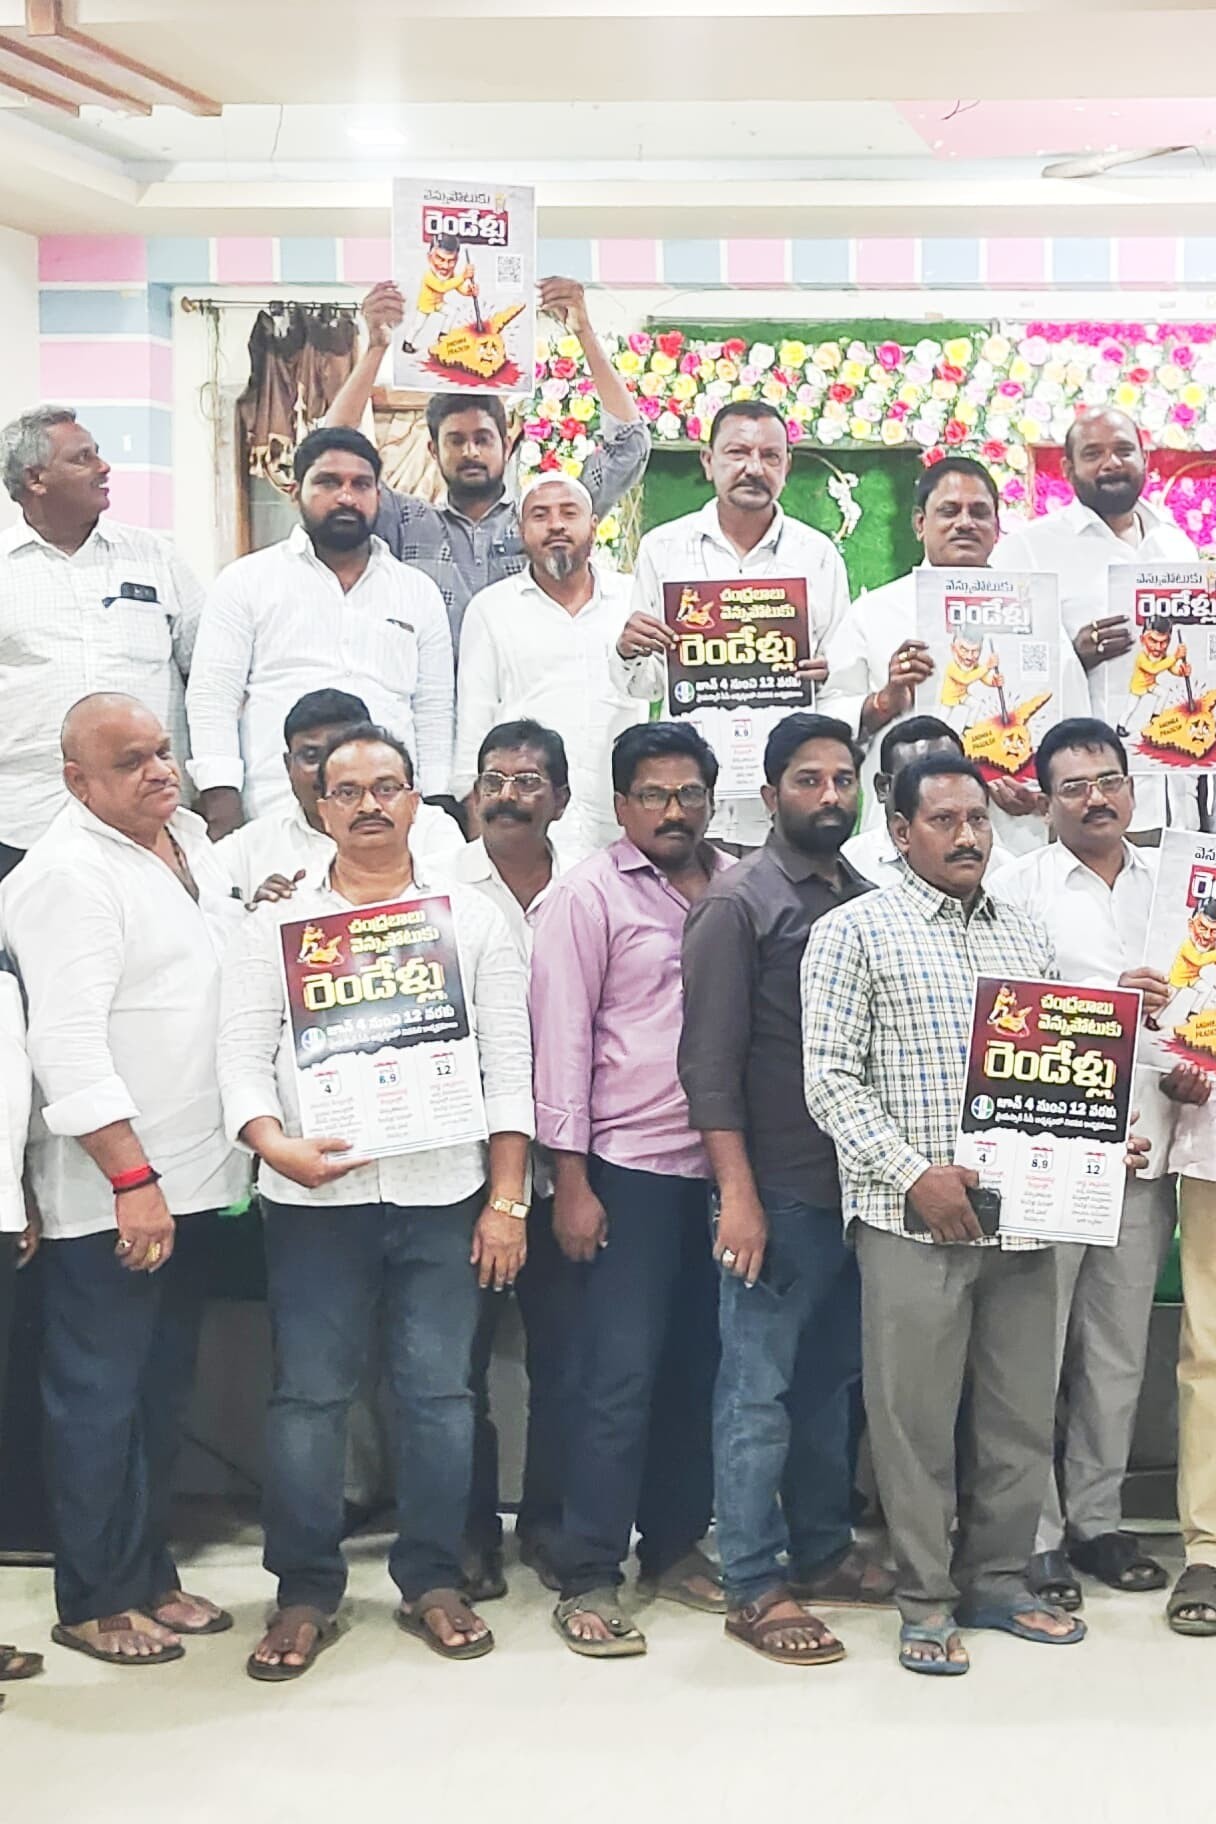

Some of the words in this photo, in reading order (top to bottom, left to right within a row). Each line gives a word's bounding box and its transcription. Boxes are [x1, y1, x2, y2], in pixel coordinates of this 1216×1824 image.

[424, 210, 506, 245] రెండేళ్లు
[1138, 590, 1216, 624] రెండేళ్లు
[679, 625, 797, 672] రెండేళ్లు
[348, 910, 426, 934] చంద్రబాబు
[302, 955, 448, 1011] రెండేళ్లు
[1041, 994, 1114, 1015] చంద్రబాబు
[437, 1065, 451, 1076] 12
[985, 1039, 1115, 1099] రెండేళ్లు
[1024, 1097, 1034, 1110] 4
[1070, 1101, 1087, 1115] 12
[979, 1153, 986, 1163] 4
[1086, 1165, 1100, 1174] 12
